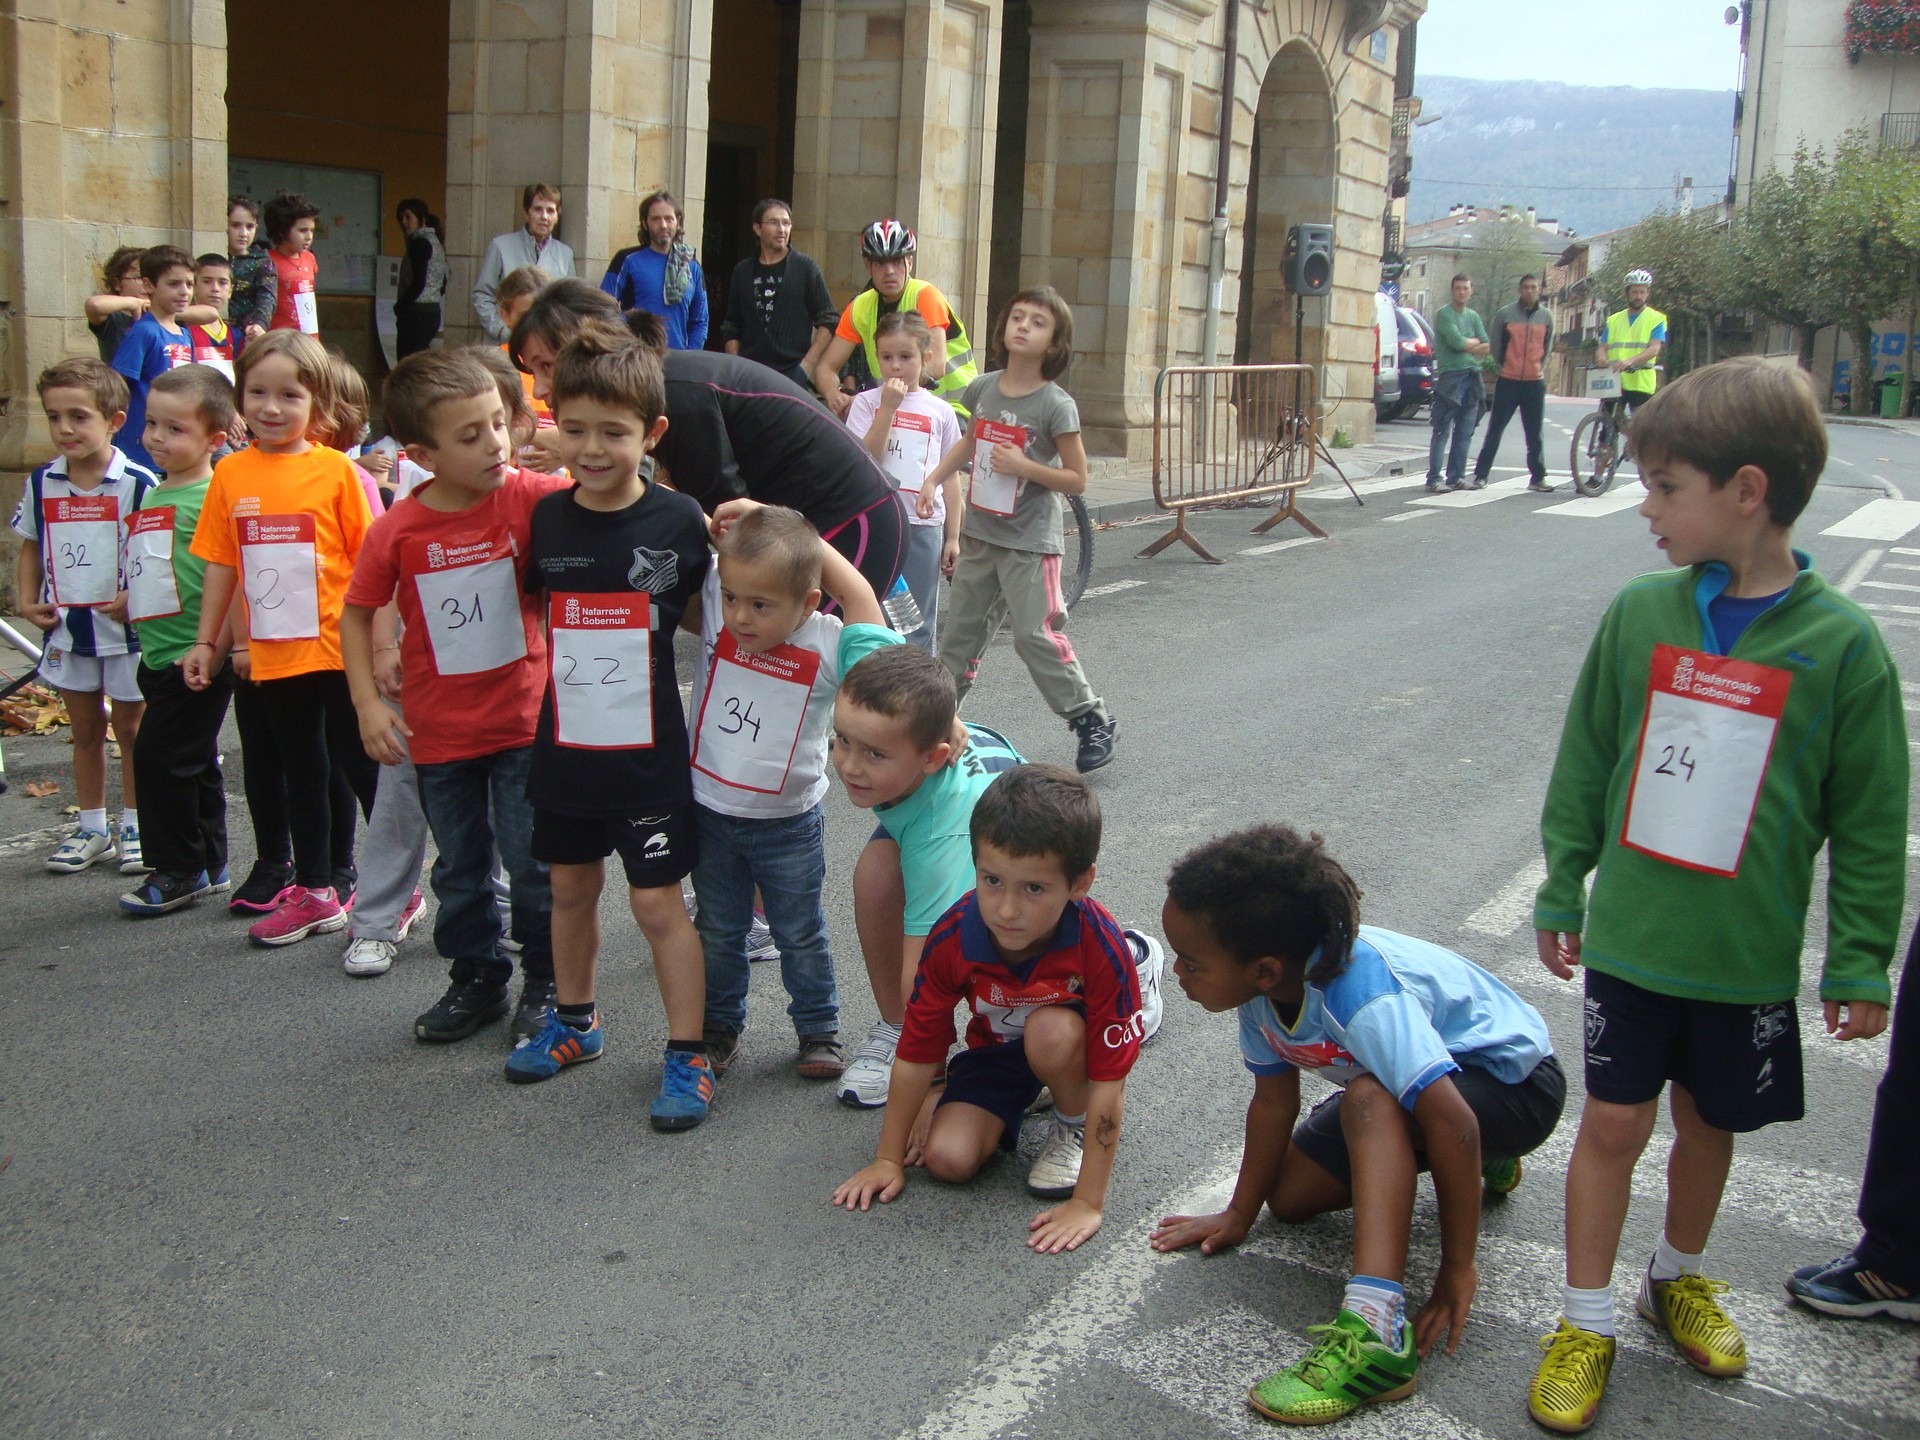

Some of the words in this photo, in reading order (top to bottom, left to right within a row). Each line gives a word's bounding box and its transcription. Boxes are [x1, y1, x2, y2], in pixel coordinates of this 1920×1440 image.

[888, 438, 902, 460] 44
[71, 505, 105, 515] Nafarroako
[71, 512, 102, 520] Gobernua
[260, 525, 300, 537] Nafarroako
[260, 533, 297, 541] Gobernua
[61, 542, 92, 569] 32
[446, 541, 493, 557] Nafarroako
[448, 551, 490, 565] Gobernua
[255, 567, 285, 610] 2
[441, 593, 483, 629] 31
[582, 607, 631, 615] Nafarroako
[582, 616, 626, 625] Gobernua
[752, 659, 793, 677] Gobernua
[1695, 670, 1761, 695] Nafarroako
[1692, 683, 1751, 705] Gobernua
[718, 697, 761, 742] 34
[1655, 745, 1694, 782] 24
[644, 849, 671, 859] ASTORE
